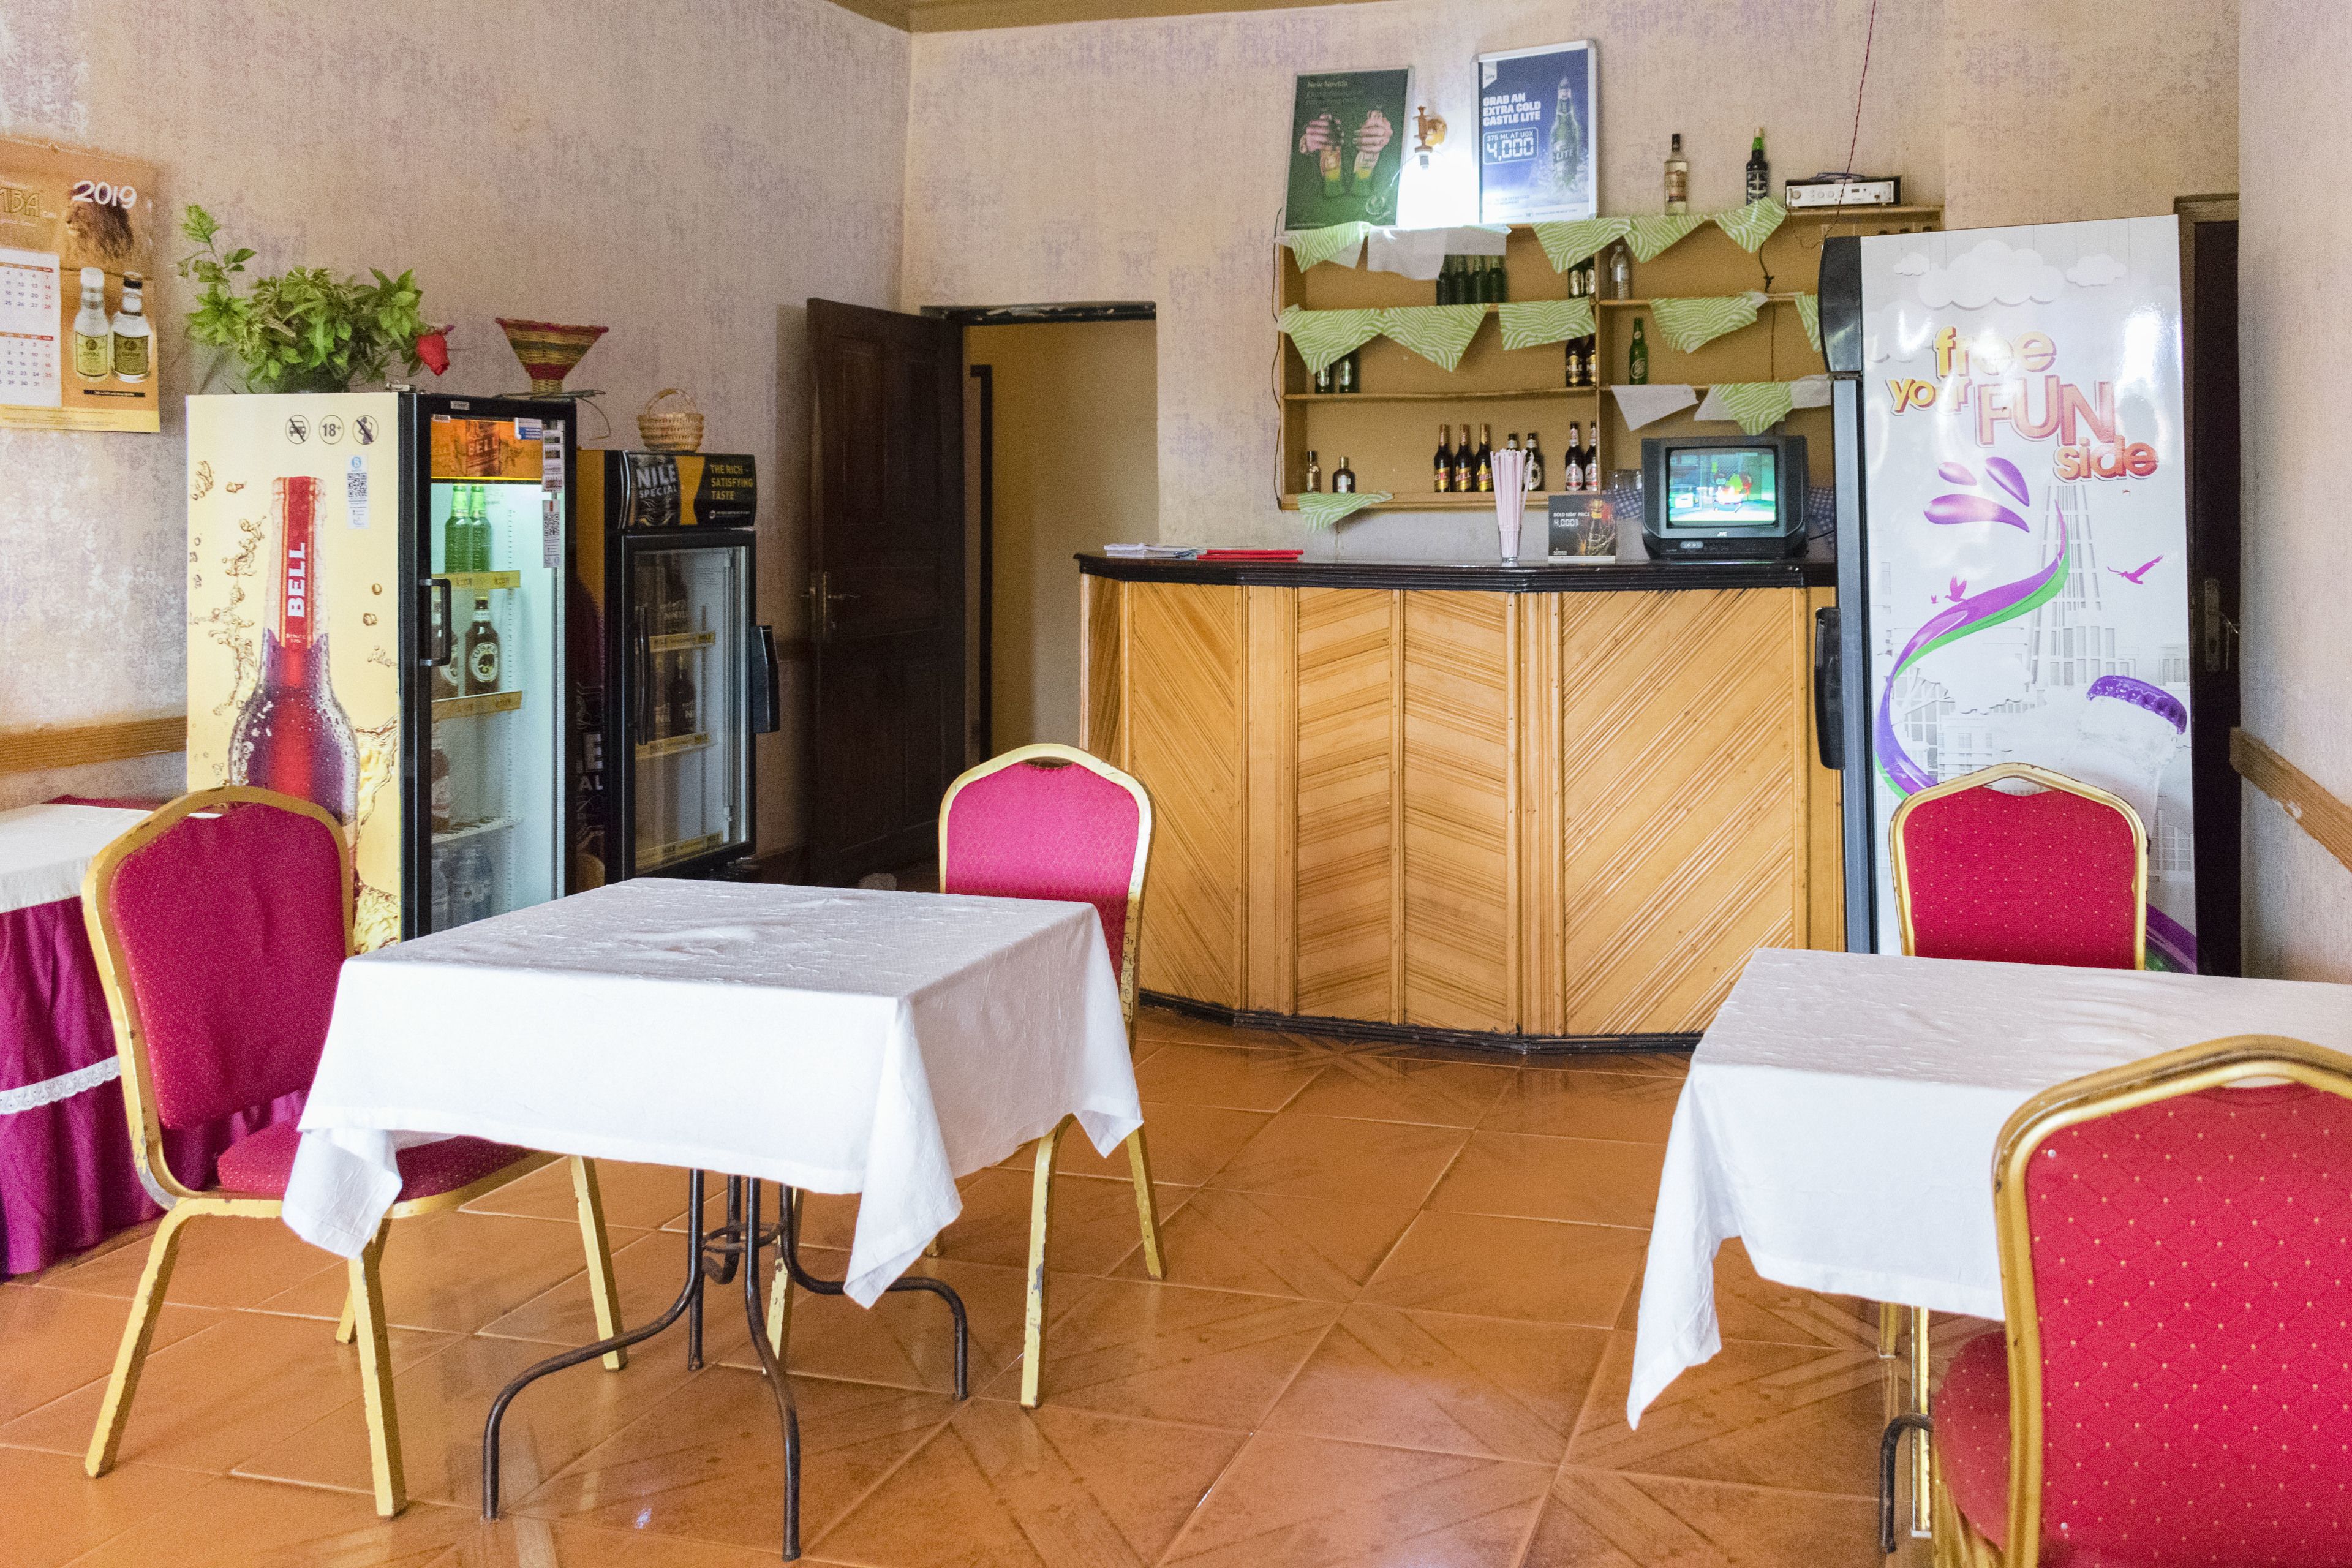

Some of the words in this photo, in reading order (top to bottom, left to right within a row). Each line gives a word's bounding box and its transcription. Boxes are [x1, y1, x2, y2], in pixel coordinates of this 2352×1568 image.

[1483, 94, 1509, 107] GRAB
[1511, 92, 1526, 103] AN
[1483, 104, 1514, 116] EXTRA
[1516, 100, 1542, 113] COLD
[1483, 114, 1519, 127] CASTLE
[1521, 111, 1541, 123] LITE
[1487, 134, 1499, 142] 375
[1487, 137, 1534, 162] 4,000
[72, 180, 137, 209] 2019
[1888, 377, 1972, 413] your
[1977, 375, 2116, 447] FUN
[322, 423, 342, 437] 18+
[467, 434, 499, 456] BELL
[2057, 435, 2158, 481] side
[636, 464, 677, 488] NILE
[710, 464, 725, 474] THE
[726, 465, 743, 475] RICH
[1479, 473, 1493, 481] BEL
[711, 478, 753, 488] SATISFYING
[639, 485, 677, 499] SPECIAL
[711, 491, 735, 500] TASTE
[288, 543, 306, 618] BELL
